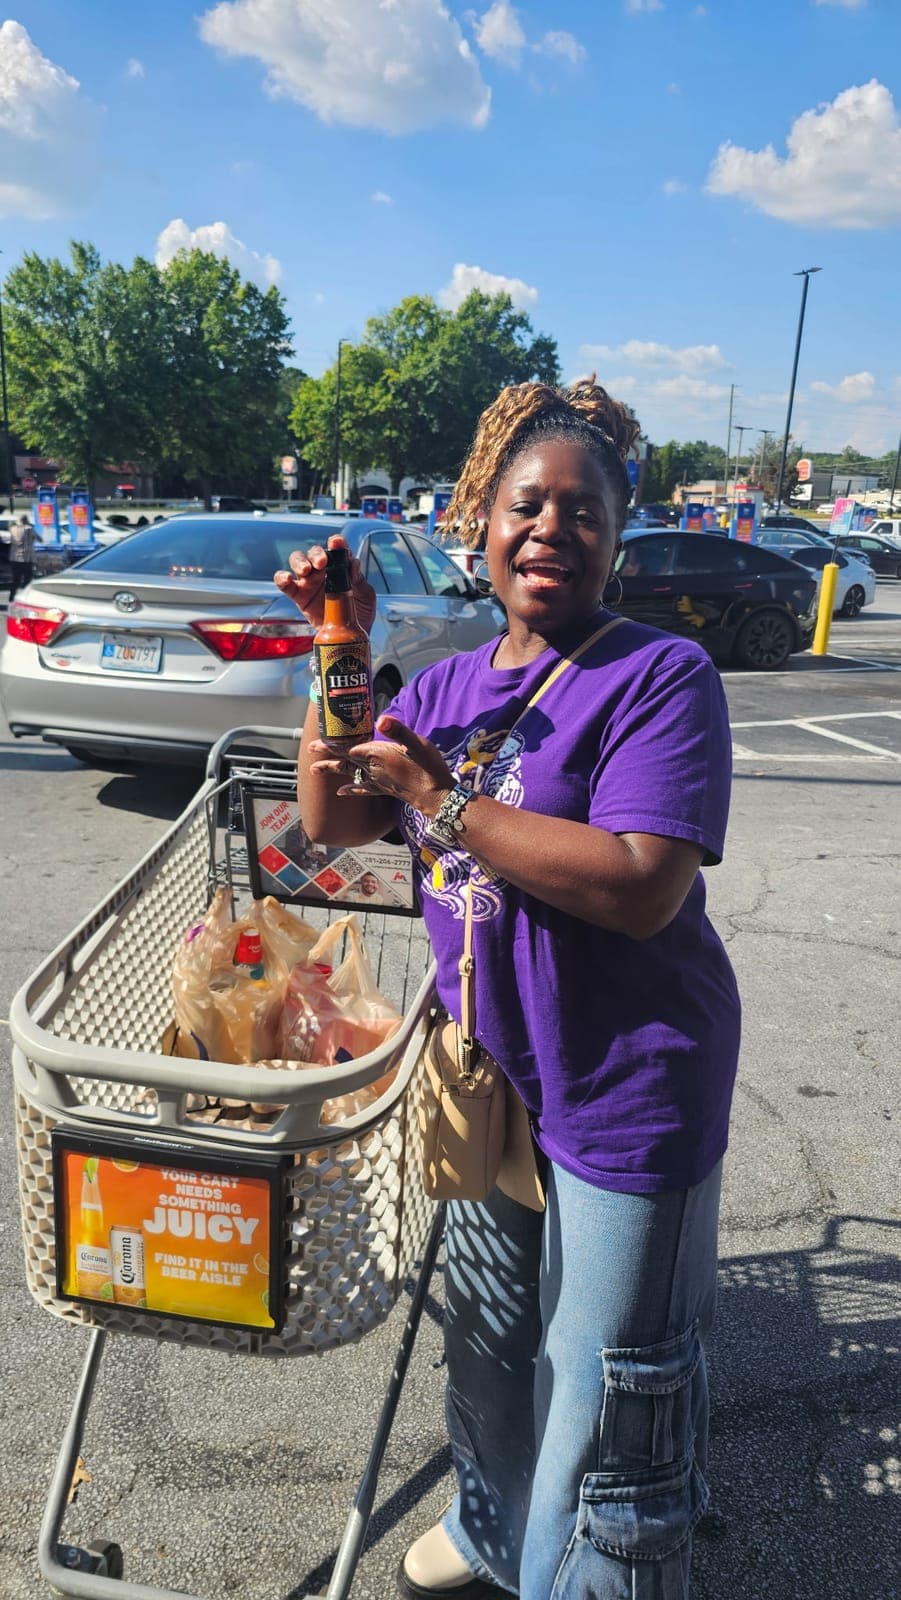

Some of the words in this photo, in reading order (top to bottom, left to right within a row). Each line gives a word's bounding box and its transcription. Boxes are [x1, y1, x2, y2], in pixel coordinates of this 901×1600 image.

[329, 672, 368, 688] IHSB
[259, 812, 275, 830] JOIN
[273, 801, 289, 816] OUR
[270, 812, 293, 832] TEAM!
[161, 1168, 197, 1184] YOUR
[200, 1174, 240, 1189] CART
[175, 1183, 222, 1200] NEEDS
[158, 1194, 242, 1215] SOMETHING
[143, 1206, 260, 1245] JUICY
[120, 1236, 136, 1284] Corona
[154, 1252, 187, 1267] FIND
[189, 1257, 202, 1269] IT
[204, 1259, 219, 1272] IN
[220, 1261, 249, 1275] THE
[161, 1265, 197, 1281] BEER
[199, 1271, 242, 1287] AISLE
